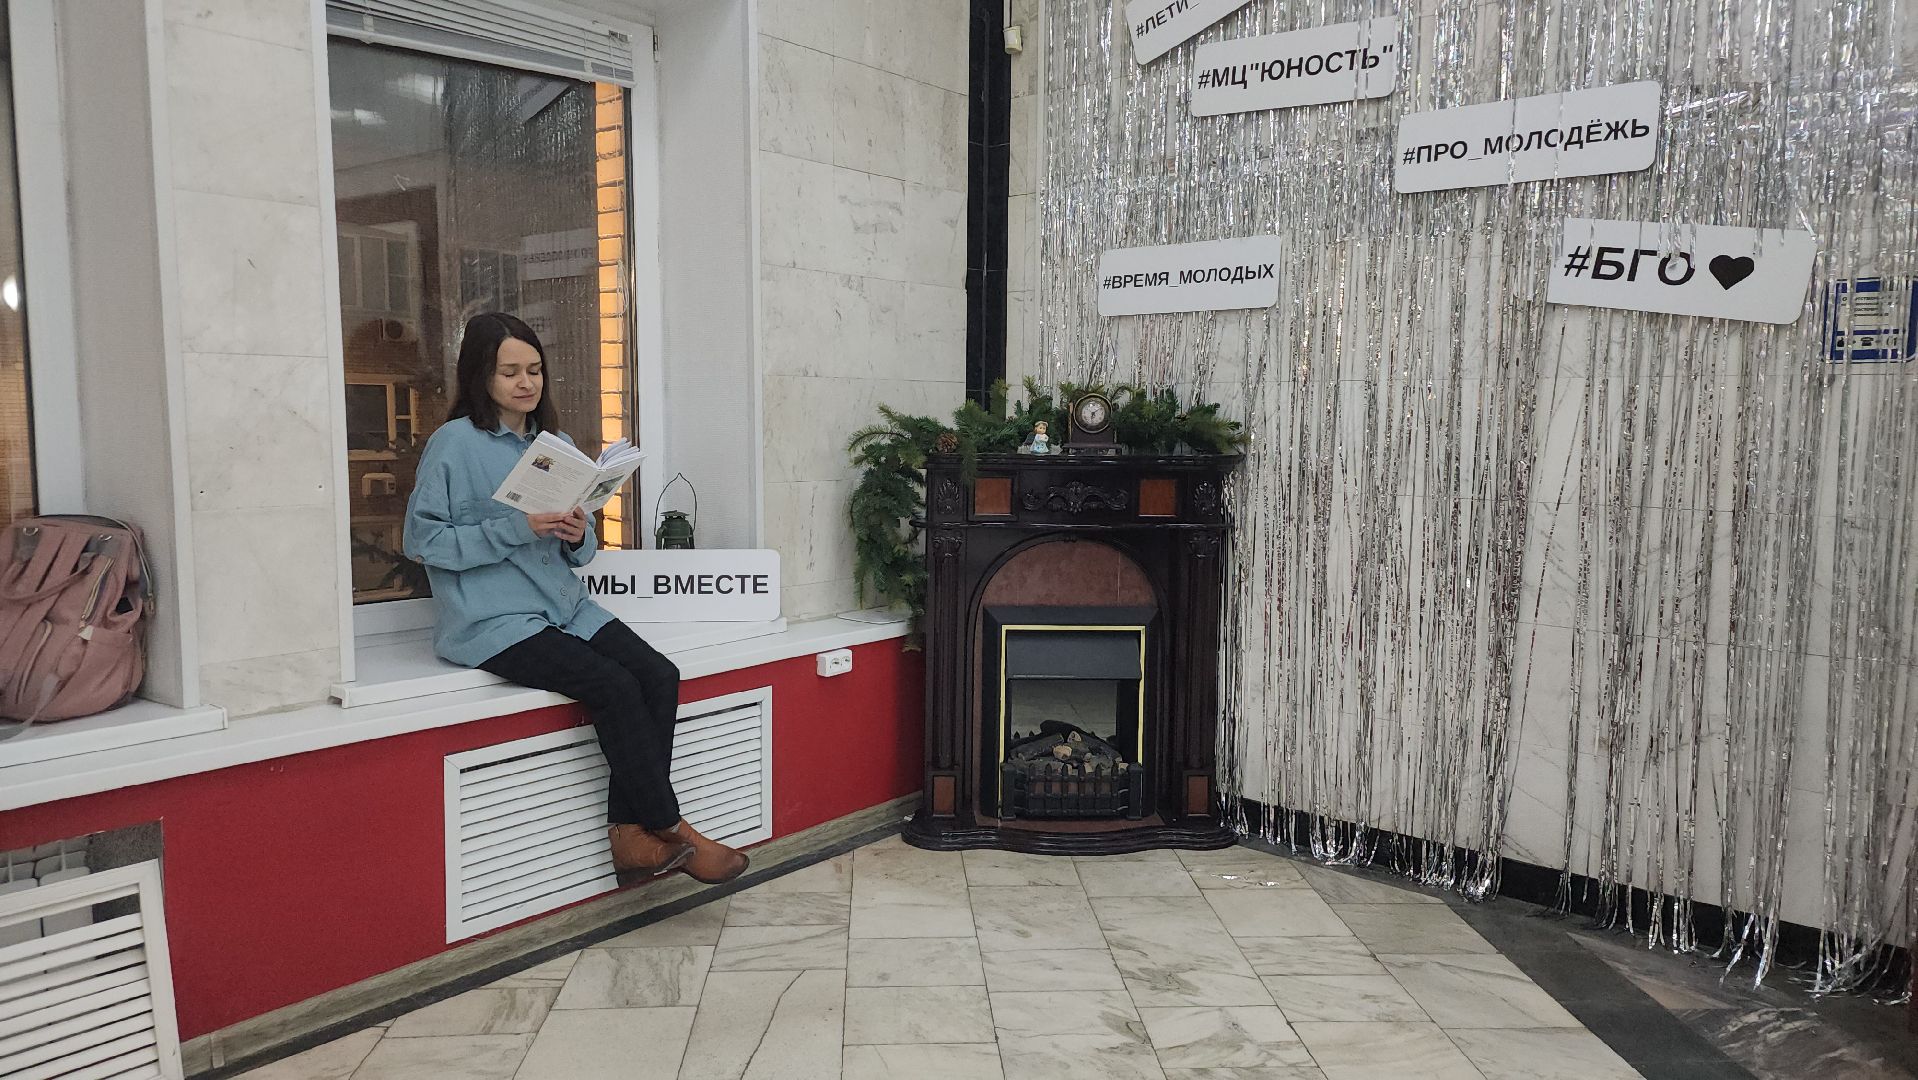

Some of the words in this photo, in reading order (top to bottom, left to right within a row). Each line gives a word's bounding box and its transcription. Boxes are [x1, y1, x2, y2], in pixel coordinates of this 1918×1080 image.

[1197, 45, 1393, 89] #МЦ"ЮНОСТЬ"
[1402, 118, 1650, 165] #ПРО_МОЛОДЁЖЬ
[1103, 263, 1275, 290] #ВРЕМЯ_МОЛОДЫХ
[1563, 245, 1696, 286] #БГО
[580, 574, 769, 599] МЫ_ВМЕСТЕ
